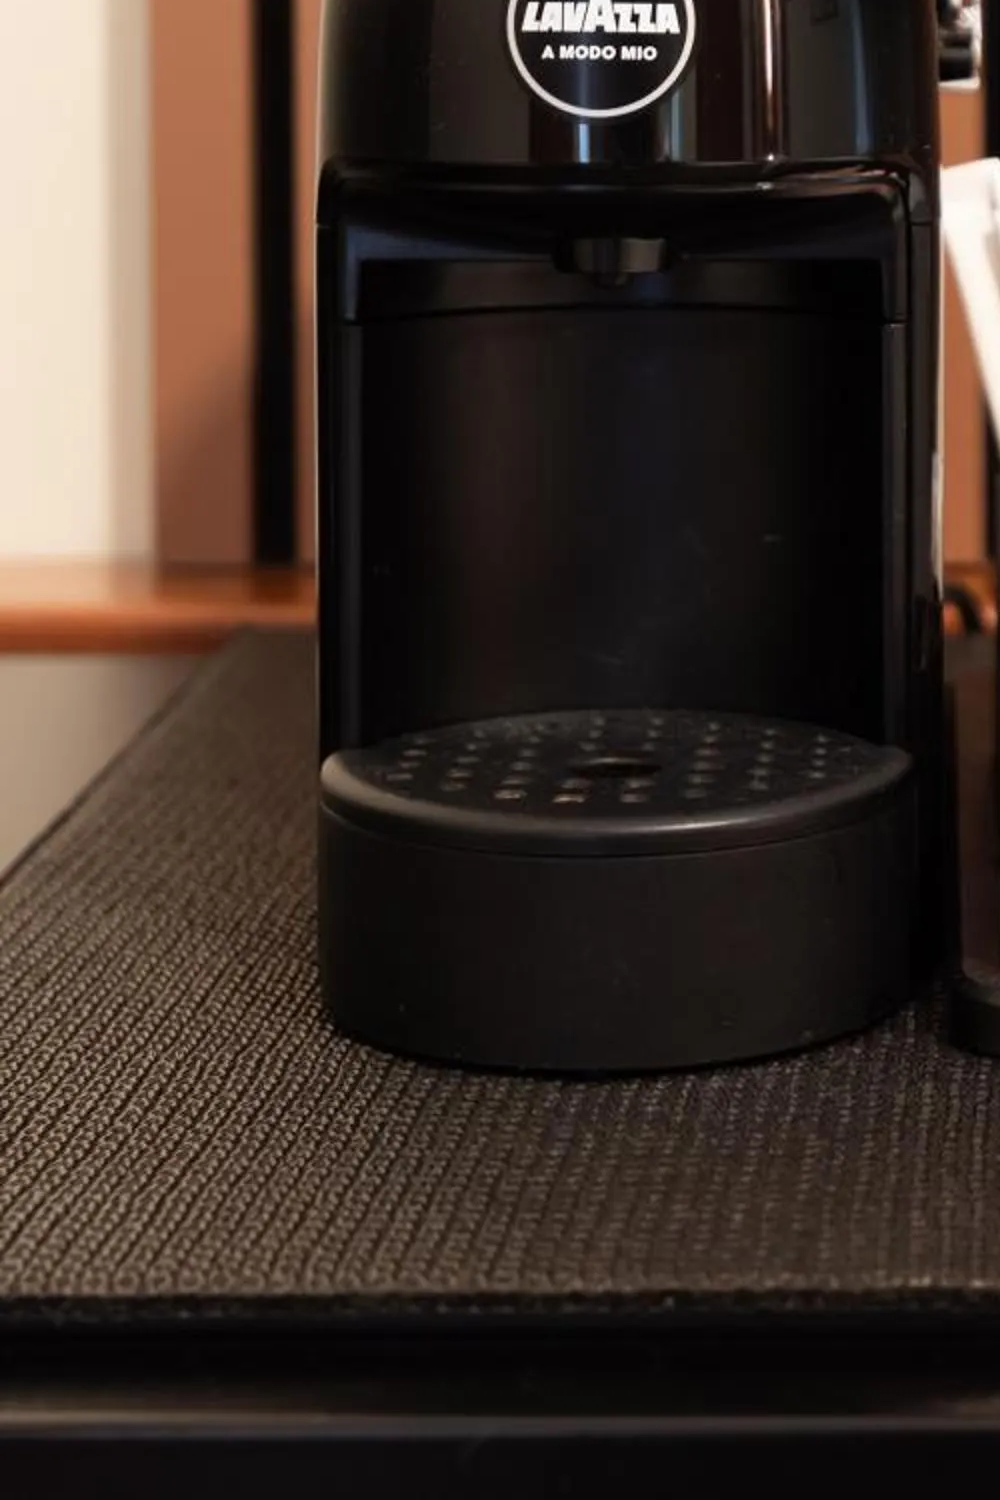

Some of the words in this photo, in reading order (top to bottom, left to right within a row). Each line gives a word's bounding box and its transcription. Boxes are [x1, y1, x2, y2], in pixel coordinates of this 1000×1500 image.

[541, 45, 555, 60] A
[559, 45, 617, 61] MODO
[621, 45, 658, 61] MIO
